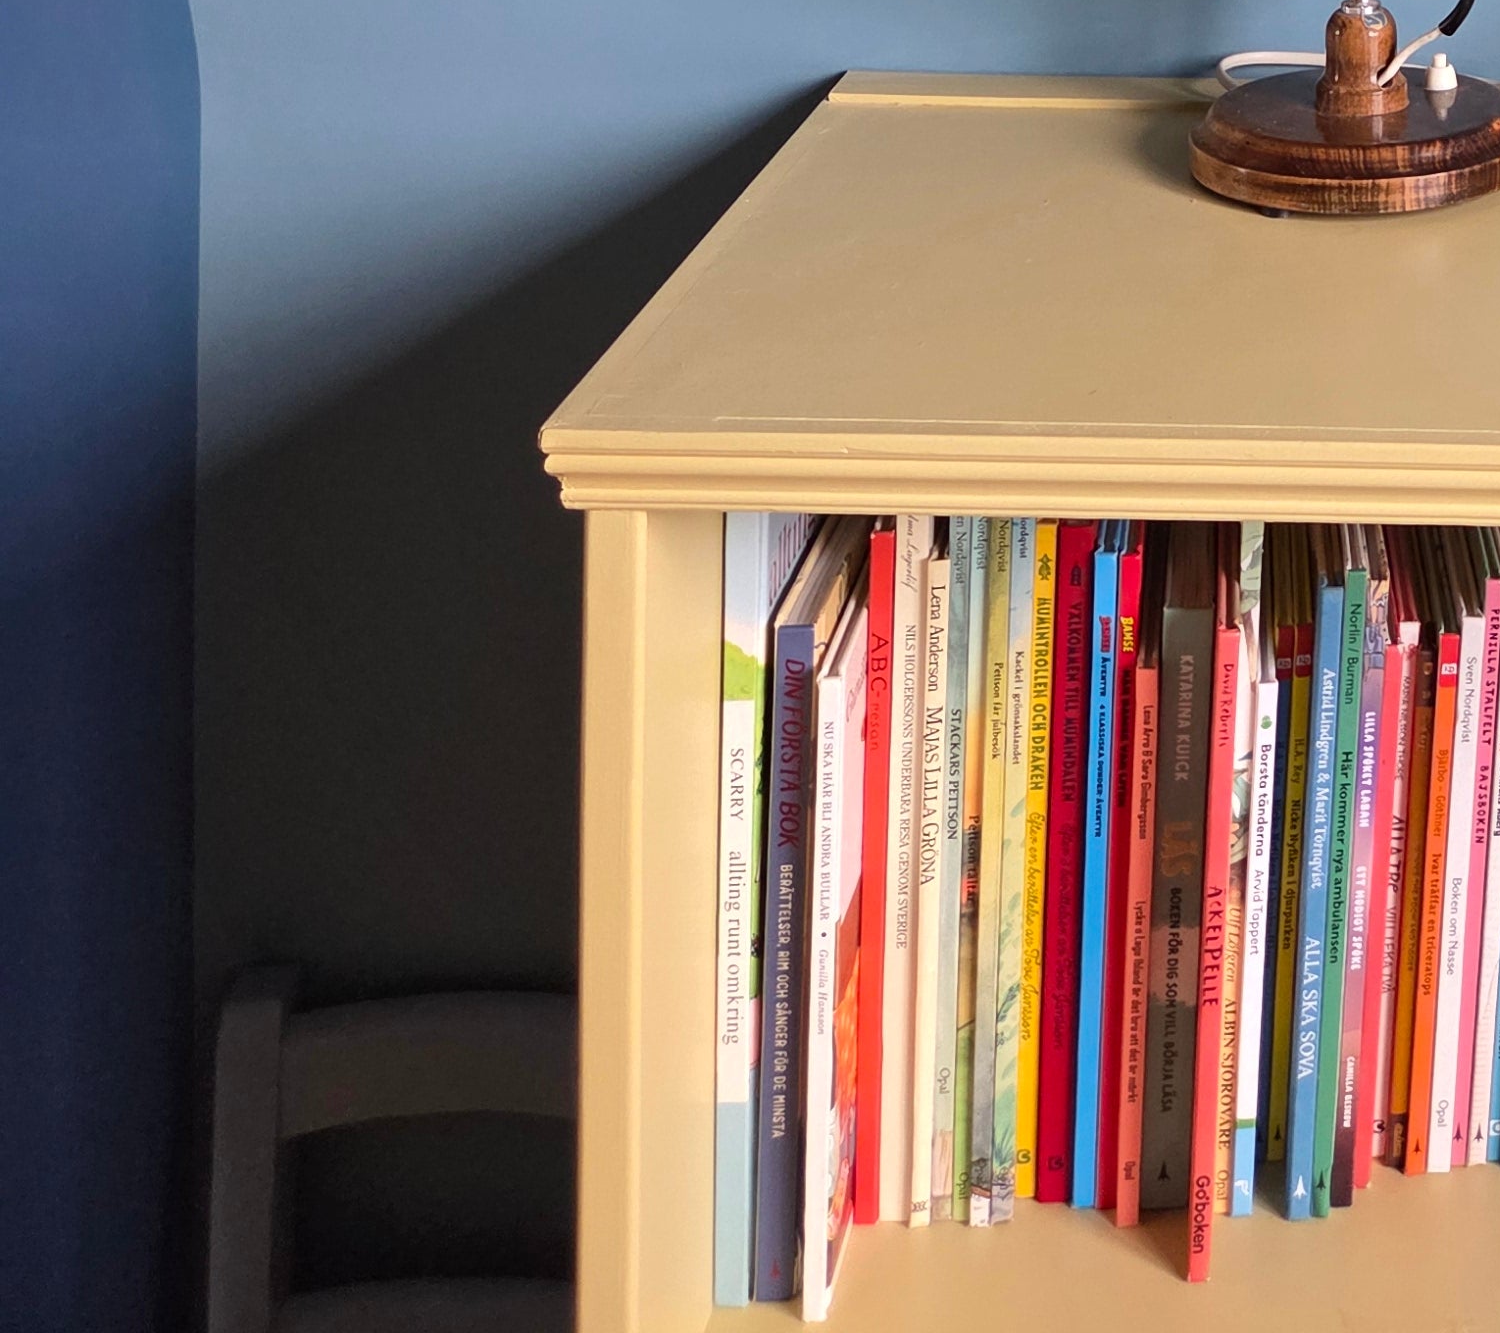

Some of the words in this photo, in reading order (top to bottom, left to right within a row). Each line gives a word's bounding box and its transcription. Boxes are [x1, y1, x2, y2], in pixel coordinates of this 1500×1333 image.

[954, 531, 966, 584] Nordqvist
[996, 519, 1008, 572] Nordqvist
[930, 585, 945, 620] Lena
[905, 625, 916, 651] NILS
[1349, 603, 1362, 644] Norlin
[1485, 609, 1500, 674] PERNILLA
[927, 624, 945, 692] Anderson
[1014, 651, 1024, 683] Kackel
[1032, 598, 1052, 699] MUMINTROLLEN
[785, 659, 805, 700] DIN
[992, 662, 1003, 698] Pettson
[1221, 664, 1234, 694] David
[1320, 668, 1335, 709] Astrid
[1344, 658, 1358, 705] Burman
[1464, 656, 1478, 684] Sven
[902, 654, 916, 738] HOLGERSSONS
[1064, 688, 1079, 712] TILL
[1177, 654, 1195, 728] KATARINA
[823, 721, 834, 739] NU
[1011, 694, 1023, 765] grönsakslandet
[1031, 703, 1046, 731] OCH
[1364, 711, 1376, 743] LILLA
[1460, 689, 1475, 743] Nordqvist
[1481, 680, 1496, 746] STALFELT
[780, 706, 804, 793] FÖRSTA
[823, 743, 834, 768] SKA
[949, 709, 961, 777] STACKARS
[1174, 734, 1191, 781] KUICK
[1316, 712, 1335, 769] Lindgren
[900, 741, 913, 815] UNDERBARA
[1029, 735, 1045, 790] DRAKEN
[1258, 744, 1273, 789] Borsta
[1318, 773, 1331, 783] &
[1340, 751, 1353, 778] Här
[729, 748, 745, 821] SCARRY
[1474, 765, 1489, 844] BAJSBOKEN
[777, 801, 801, 848] BOK
[822, 801, 832, 822] BLI
[947, 781, 960, 840] PETTSON
[1255, 793, 1271, 856] tänderna
[1315, 788, 1330, 823] Marit
[1337, 783, 1350, 844] kommer
[820, 826, 831, 868] ANDRA
[898, 818, 910, 848] RESA
[1160, 820, 1202, 877] LÄS
[899, 851, 910, 895] GENOM
[1308, 826, 1327, 890] Törnqvist
[1331, 849, 1345, 874] nya
[1430, 853, 1442, 875] Ivar
[725, 851, 746, 912] allting
[819, 872, 830, 921] BULLAR
[1252, 869, 1266, 902] Arvid
[1427, 879, 1441, 915] träffar
[1450, 877, 1462, 915] Boken
[776, 864, 794, 948] BERÄTTELSER,
[895, 899, 908, 949] SVERIGE
[1169, 887, 1182, 928] BOKEN
[1329, 877, 1347, 964] ambulansen
[1426, 920, 1435, 932] en
[727, 918, 741, 957] runt
[1167, 932, 1183, 955] FÖR
[1249, 905, 1264, 955] Tappert
[1449, 918, 1458, 936] om
[776, 950, 790, 971] RIM
[1022, 950, 1039, 980] Tove
[1166, 958, 1179, 979] DIG
[1303, 936, 1320, 985] ALLA
[1422, 936, 1437, 996] triceratops
[1446, 940, 1460, 976] Nasse
[721, 964, 743, 1046] omkring
[776, 975, 789, 998] OCH
[1165, 983, 1178, 1008] SOM
[774, 1002, 792, 1047] SÅNGER
[1164, 1011, 1177, 1036] VILL
[1223, 998, 1238, 1048] ALBIN
[1300, 990, 1319, 1025] SKA
[773, 1051, 789, 1072] FÖR
[1162, 1041, 1178, 1080] BÖRJA
[1297, 1031, 1315, 1080] SOVA
[772, 1076, 786, 1091] DE
[938, 1067, 950, 1094] Opal
[1160, 1083, 1174, 1113] LÄSA
[771, 1095, 787, 1138] MINSTA
[1436, 1100, 1449, 1127] Opal
[957, 1172, 969, 1200] Opal
[1214, 1170, 1228, 1200] Opal
